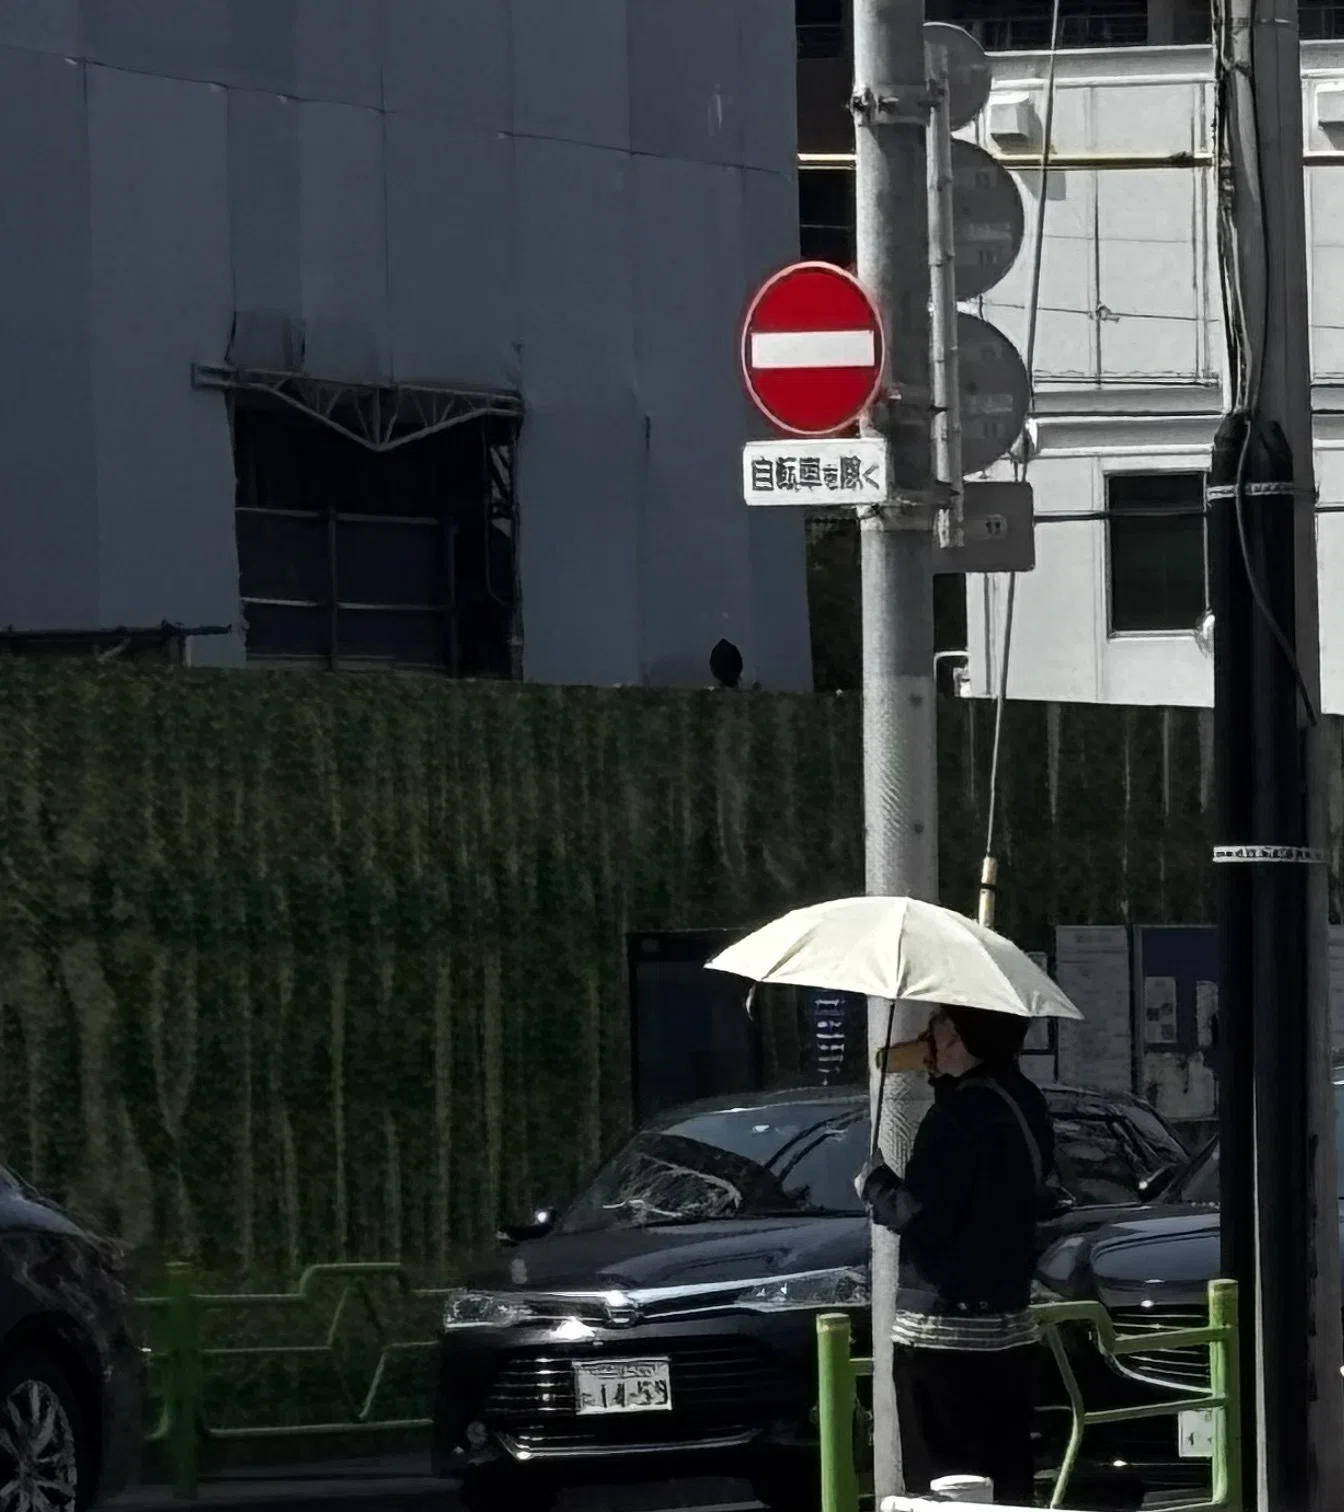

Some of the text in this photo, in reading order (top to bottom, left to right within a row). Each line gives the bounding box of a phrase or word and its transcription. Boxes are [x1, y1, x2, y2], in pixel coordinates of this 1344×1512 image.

[751, 455, 880, 492] 自転車を除く
